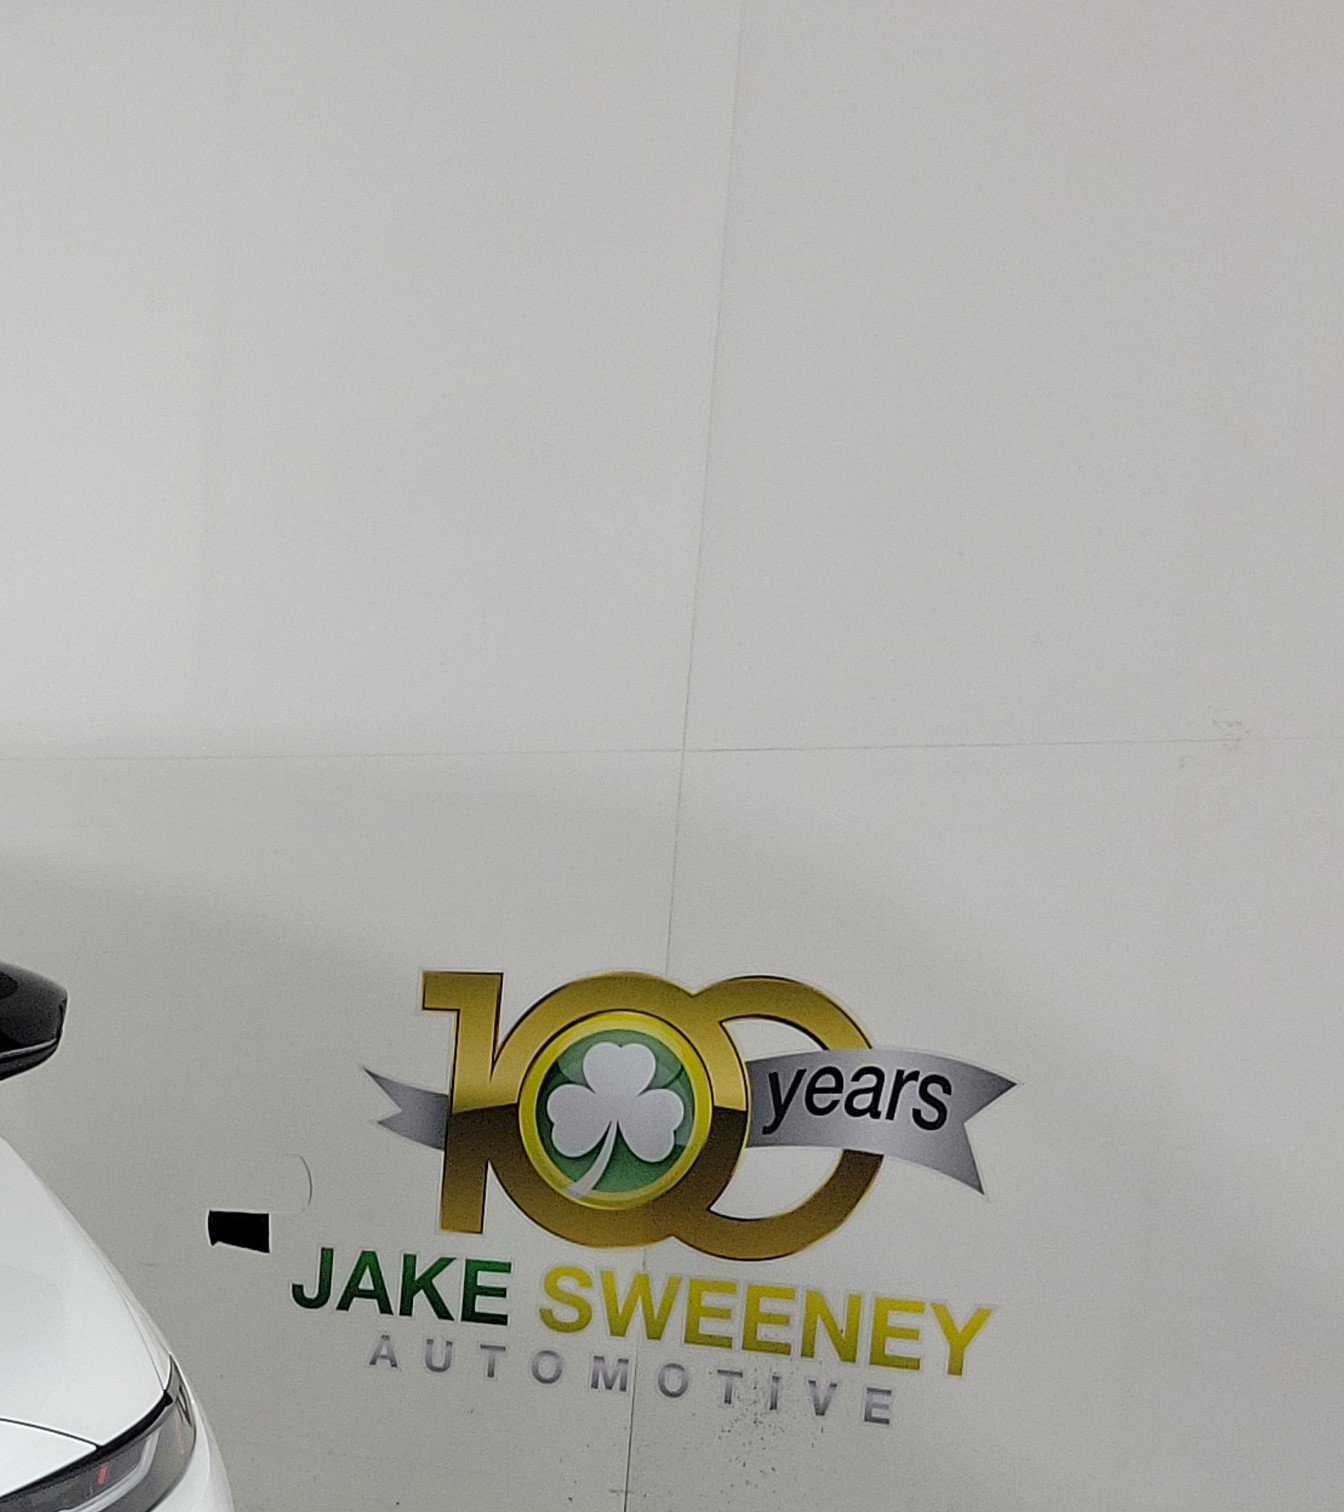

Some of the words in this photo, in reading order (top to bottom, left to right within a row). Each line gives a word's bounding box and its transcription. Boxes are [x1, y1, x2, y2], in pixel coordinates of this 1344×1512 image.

[421, 970, 886, 1262] 100
[761, 1063, 954, 1136] years
[290, 1247, 512, 1327] JAKE
[538, 1265, 997, 1378] SWEENEY
[368, 1334, 895, 1426] AUTOMOTIVE
